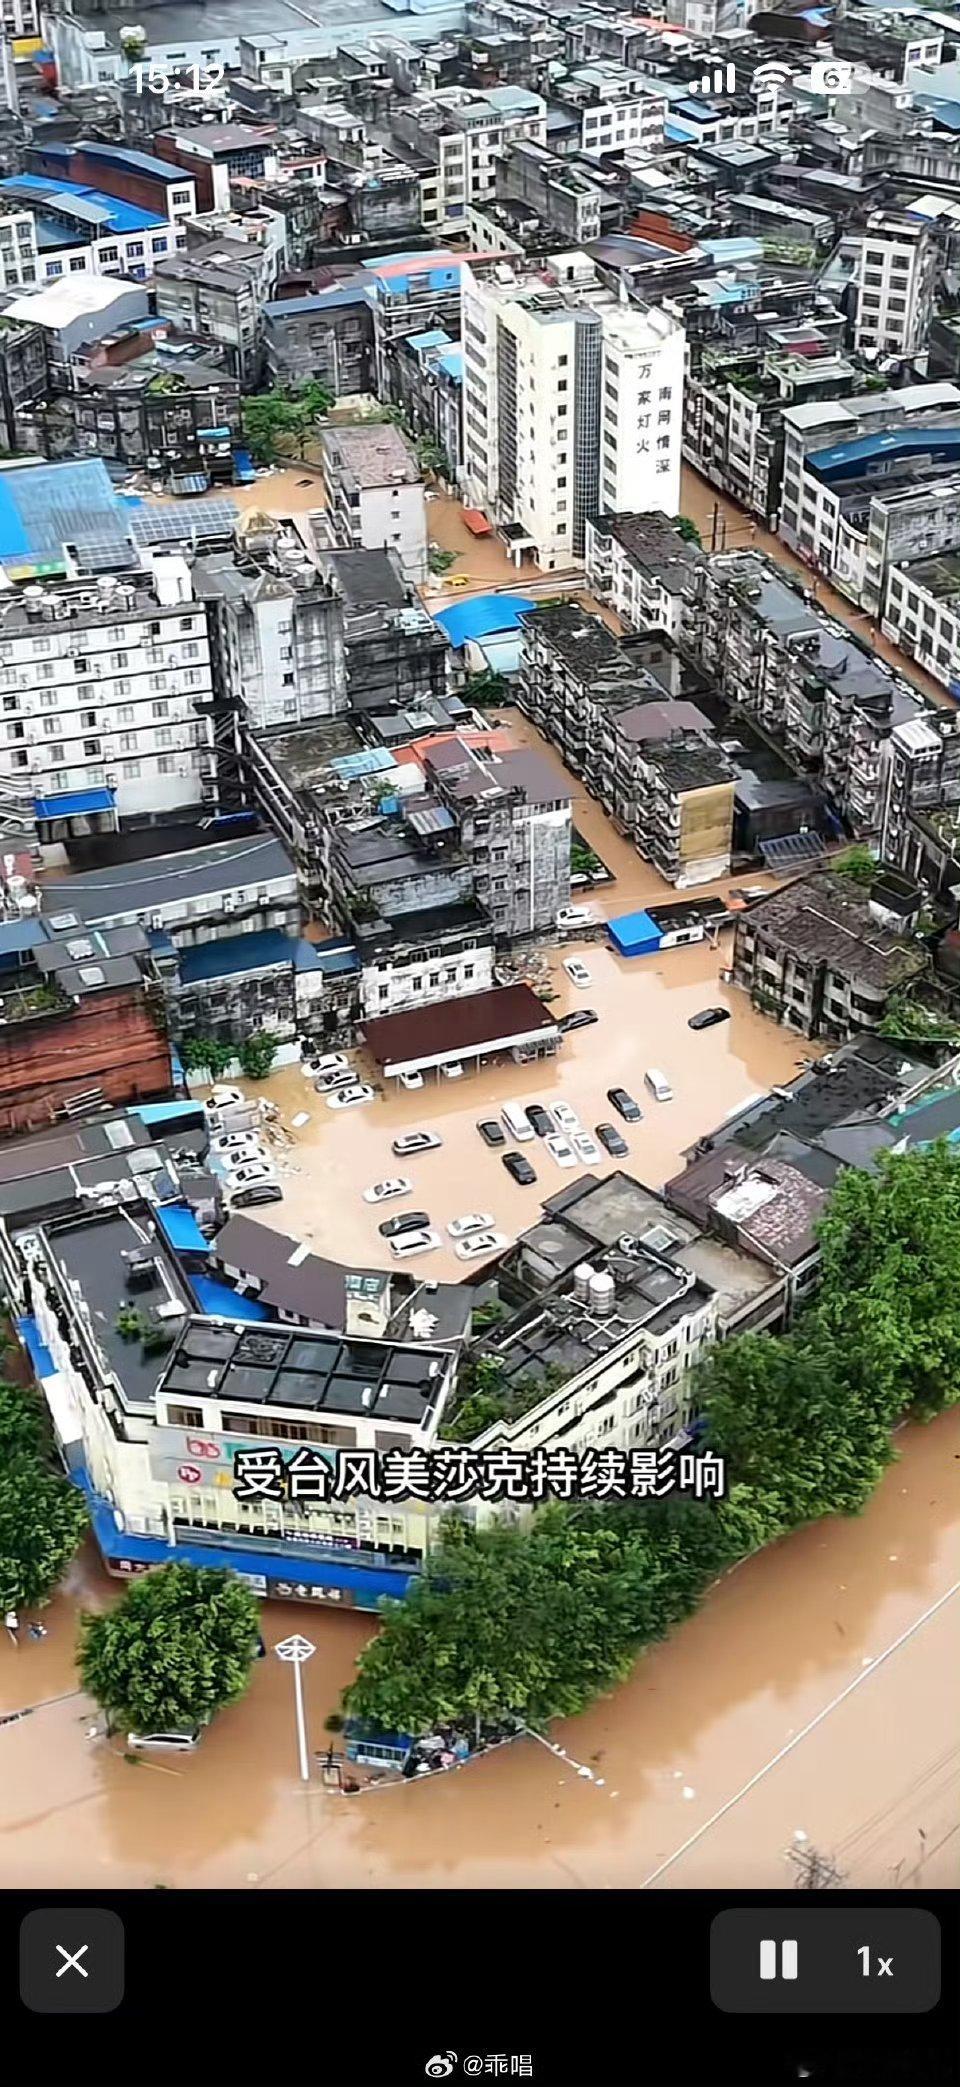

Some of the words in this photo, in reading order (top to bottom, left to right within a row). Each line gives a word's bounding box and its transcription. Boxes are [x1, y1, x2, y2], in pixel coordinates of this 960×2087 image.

[636, 363, 652, 454] 万家灯火
[655, 386, 672, 474] 南网情深
